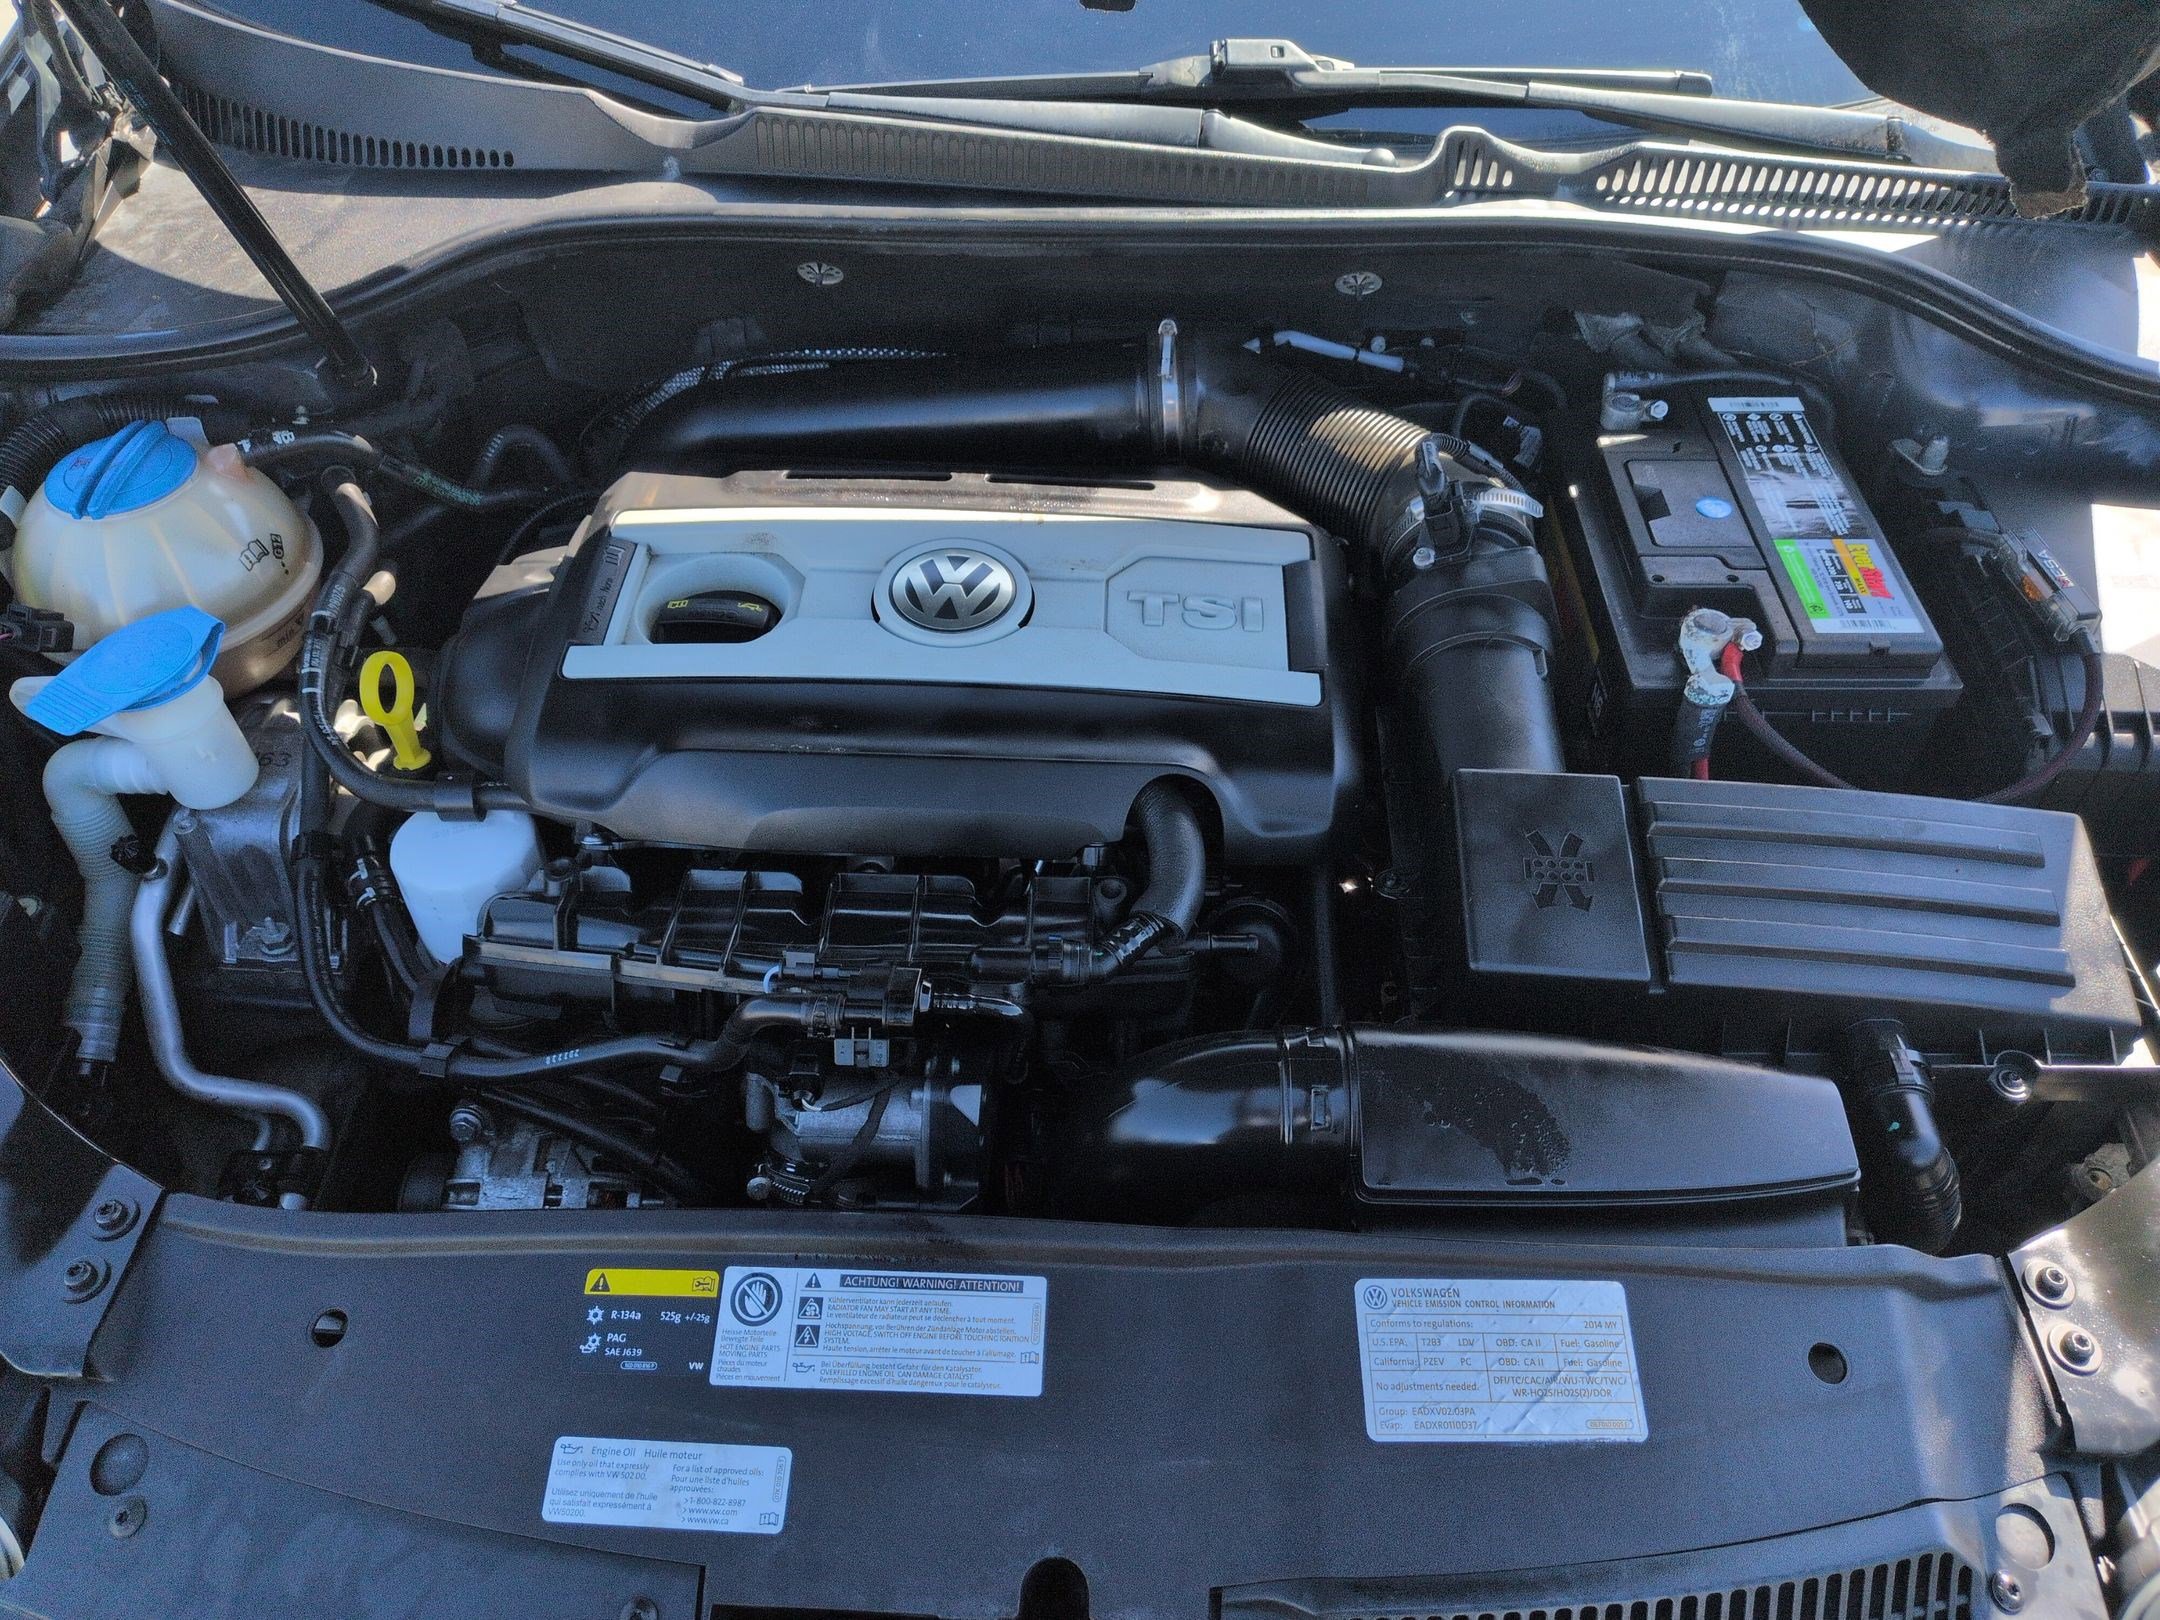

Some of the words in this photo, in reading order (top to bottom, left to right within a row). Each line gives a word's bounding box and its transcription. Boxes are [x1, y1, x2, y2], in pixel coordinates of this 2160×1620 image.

[271, 534, 284, 559] G12
[1127, 590, 1264, 633] TSI
[844, 1276, 899, 1288] ACHTUNG!
[902, 1278, 956, 1290] WARNING!
[959, 1280, 1020, 1292] ATTENTION!
[1390, 1288, 1460, 1298] VOLKSWAGEN
[1392, 1300, 1422, 1308] VEHICLE
[1425, 1300, 1461, 1308] EMISSION
[1465, 1300, 1499, 1308] CONTROL
[1503, 1300, 1555, 1308] INFORMATION
[611, 1310, 641, 1320] R-134a
[660, 1312, 681, 1324] 525g
[685, 1312, 710, 1324] +/-25g
[1370, 1320, 1410, 1328] Conforms
[1412, 1320, 1422, 1328] to
[1424, 1320, 1473, 1329] regulations:
[1584, 1321, 1602, 1329] 2014
[1604, 1321, 1617, 1329] MY
[607, 1334, 626, 1342] PAG
[1458, 1338, 1474, 1346] LDV
[1496, 1339, 1518, 1347] OBD:
[1561, 1339, 1580, 1347] Fuel:
[1584, 1339, 1619, 1348] Gasoline
[604, 1348, 620, 1356] SAE
[622, 1348, 642, 1357] J639
[688, 1362, 704, 1370] VW
[1374, 1358, 1417, 1366] California:
[1461, 1358, 1471, 1366] PC
[1498, 1358, 1520, 1366] OBD:
[1524, 1358, 1536, 1366] CA
[1564, 1359, 1583, 1367] Fuel:
[1587, 1359, 1622, 1367] Gasoline
[820, 1369, 857, 1377] OVERFILLED
[819, 1377, 859, 1385] Remplissage
[908, 1379, 943, 1388] dangereux
[1376, 1382, 1388, 1390] No
[1390, 1382, 1443, 1392] adjustments
[1446, 1382, 1479, 1390] needed.
[1378, 1407, 1408, 1417] Group:
[1380, 1421, 1402, 1430] Evap:
[592, 1446, 622, 1457] Engine
[623, 1448, 636, 1456] Oil
[644, 1449, 667, 1458] Huile
[670, 1451, 702, 1460] moteur
[572, 1460, 588, 1468] only
[616, 1462, 650, 1472] expressly
[673, 1464, 684, 1472] For
[692, 1465, 703, 1473] list
[705, 1466, 713, 1474] of
[714, 1467, 747, 1477] approved
[555, 1469, 586, 1478] complies
[588, 1470, 604, 1478] with
[606, 1471, 620, 1479] VW
[703, 1476, 720, 1484] liste
[551, 1488, 578, 1496] Utilisez
[580, 1490, 624, 1500] uniquement
[549, 1499, 560, 1507] qui
[562, 1499, 591, 1508] satisfait
[689, 1508, 738, 1516] www.vw.com
